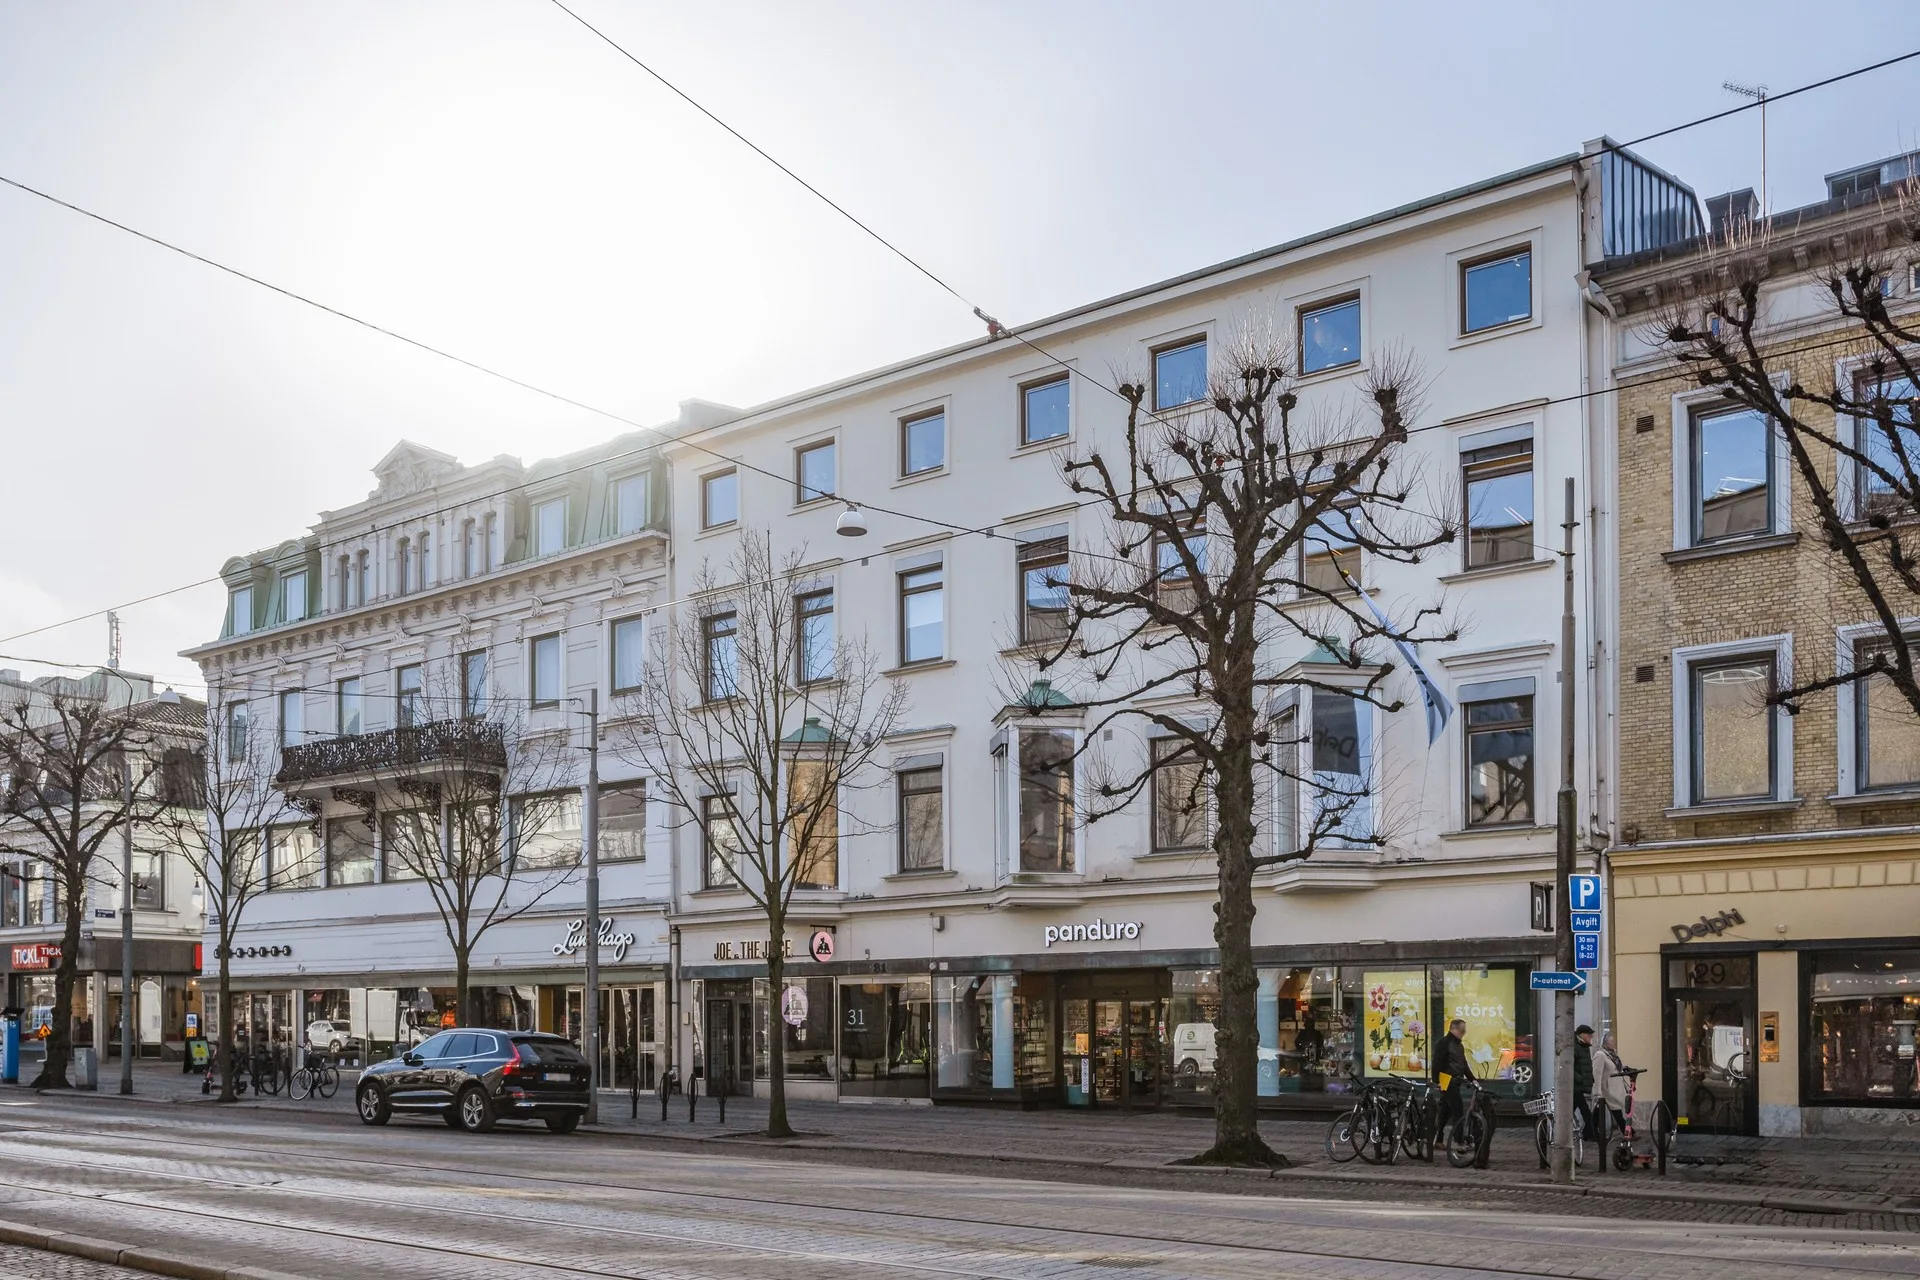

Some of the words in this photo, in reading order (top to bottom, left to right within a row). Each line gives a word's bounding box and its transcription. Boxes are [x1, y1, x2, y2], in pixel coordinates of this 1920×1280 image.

[1580, 878, 1595, 907] P
[1575, 917, 1598, 928] Avgift
[1671, 908, 1745, 943] Delphi
[552, 917, 634, 962] Lunhags
[1045, 918, 1139, 947] panduro
[40, 947, 62, 956] TICK
[213, 945, 290, 959] LKRITS
[713, 942, 732, 960] JOE
[740, 940, 760, 960] THE
[762, 939, 791, 959] JCE
[1533, 977, 1571, 985] P-automat
[1695, 963, 1726, 984] 29
[847, 1008, 864, 1025] 31
[1455, 1002, 1504, 1018] störst
